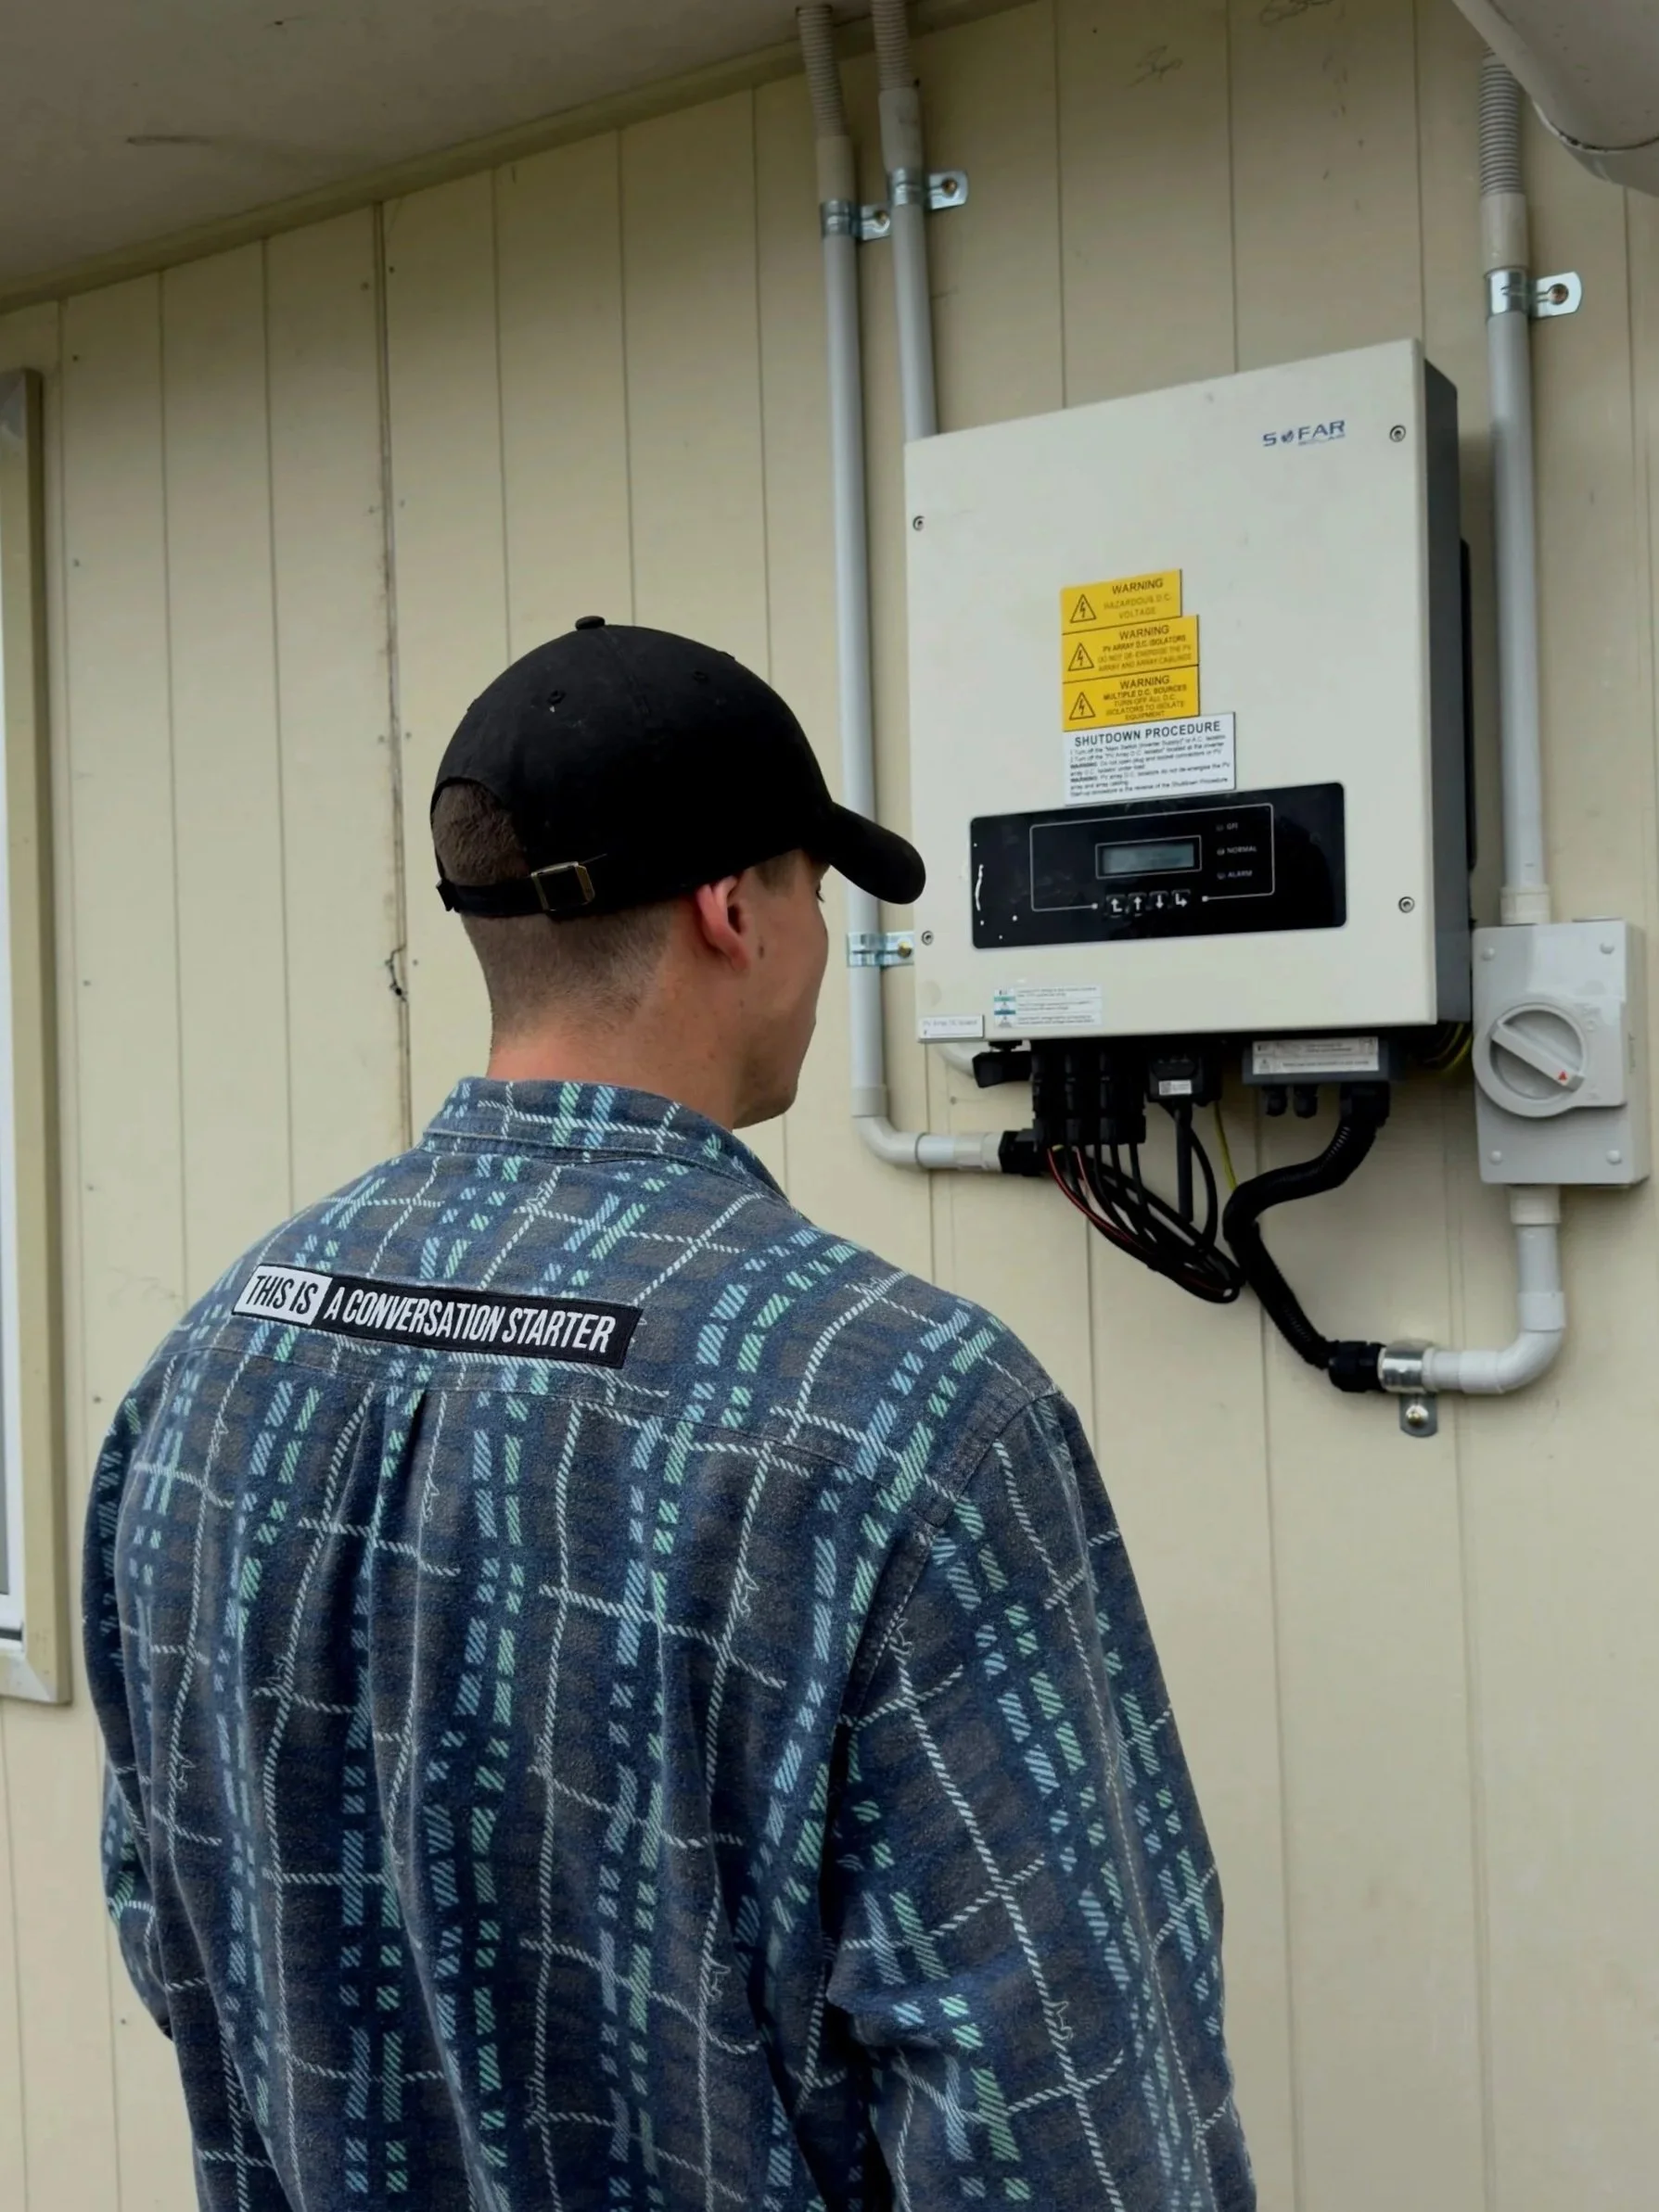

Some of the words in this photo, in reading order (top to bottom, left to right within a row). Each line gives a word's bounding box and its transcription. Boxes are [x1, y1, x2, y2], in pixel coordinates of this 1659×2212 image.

[1112, 578, 1163, 594] WARNING
[1104, 595, 1154, 610] HAZARDOUS
[1118, 606, 1155, 618] VOLTAGE
[1119, 625, 1168, 639] WARNING
[1113, 642, 1133, 651] ARRAY
[1149, 636, 1185, 646] ISOLATORS
[1135, 658, 1156, 667] ARRAY
[1120, 675, 1169, 689] WARNING
[1103, 690, 1135, 699] MULTIPLE
[1153, 684, 1186, 694] SOURCES
[1105, 704, 1143, 716] ISOLATORS
[1145, 703, 1154, 711] TO
[1125, 710, 1164, 720] EQUIPMENT
[1074, 730, 1141, 747] SHUTDOWN
[1145, 720, 1219, 739] PROCEDURE
[1226, 845, 1257, 854] NORMAL
[1228, 870, 1253, 878] ALARM
[246, 1275, 295, 1310] THIS
[289, 1281, 319, 1315] IS
[324, 1287, 345, 1320] A
[342, 1289, 506, 1342] CONVERSATION
[502, 1307, 616, 1354] STARTER
